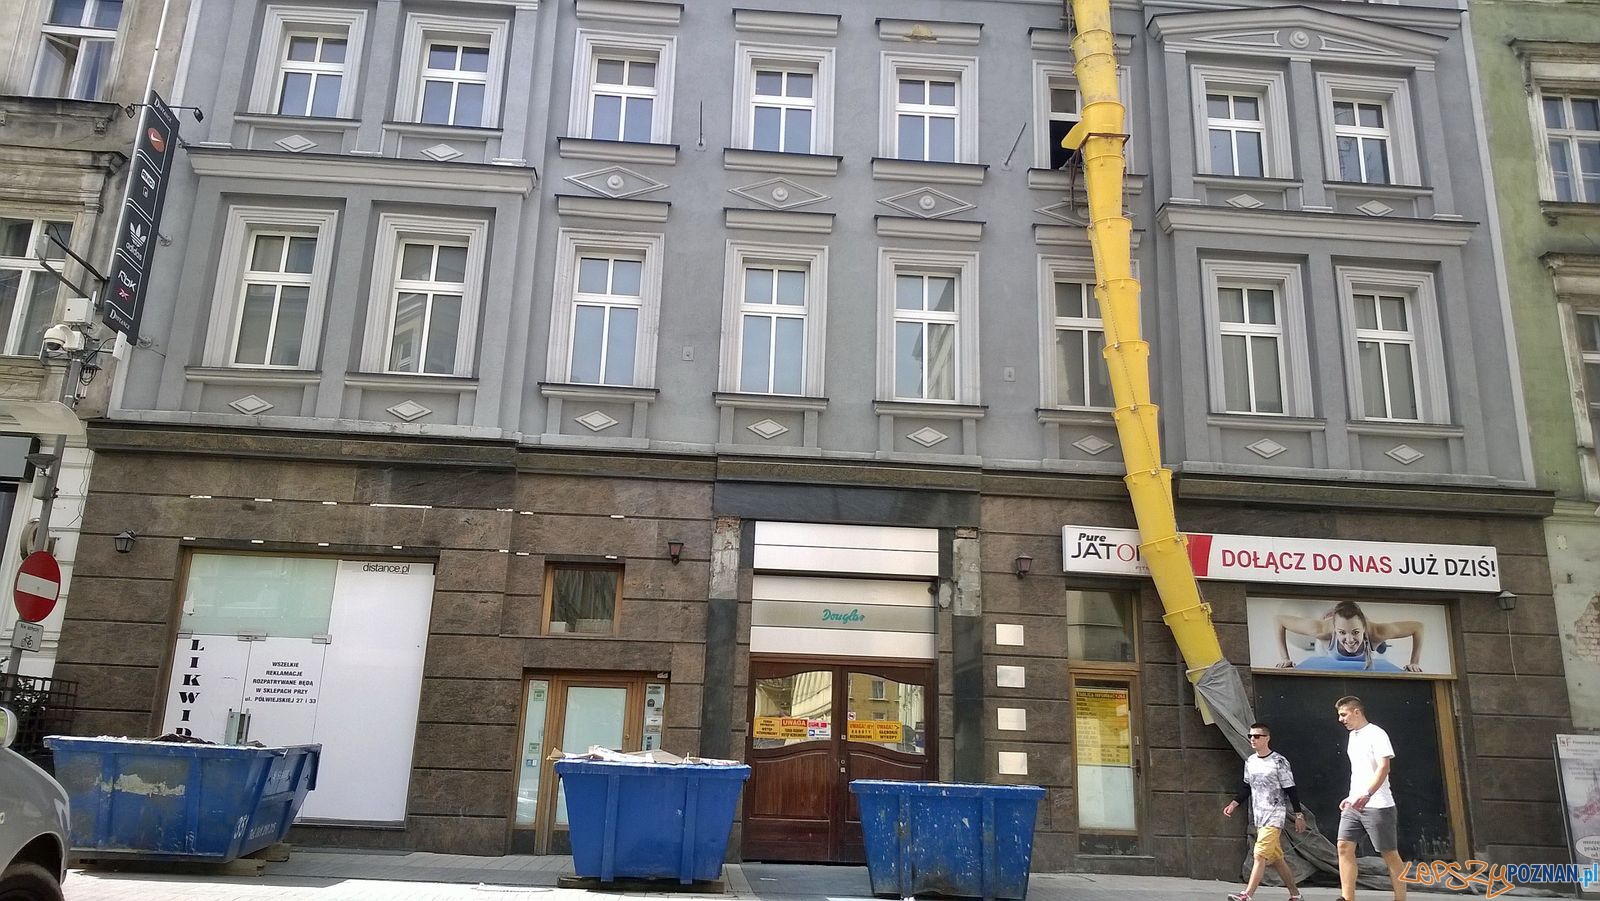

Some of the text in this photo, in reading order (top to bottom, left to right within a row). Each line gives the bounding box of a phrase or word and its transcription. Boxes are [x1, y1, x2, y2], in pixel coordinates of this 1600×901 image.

[126, 242, 142, 261] adidas
[1078, 533, 1107, 543] Pure
[362, 563, 411, 575] distance.pl
[1221, 549, 1497, 578] DOŁĄCZ DO NAS JUŻ DZIŚ!
[822, 608, 865, 624] Douglas
[252, 678, 297, 686] ROZPATRYWANE
